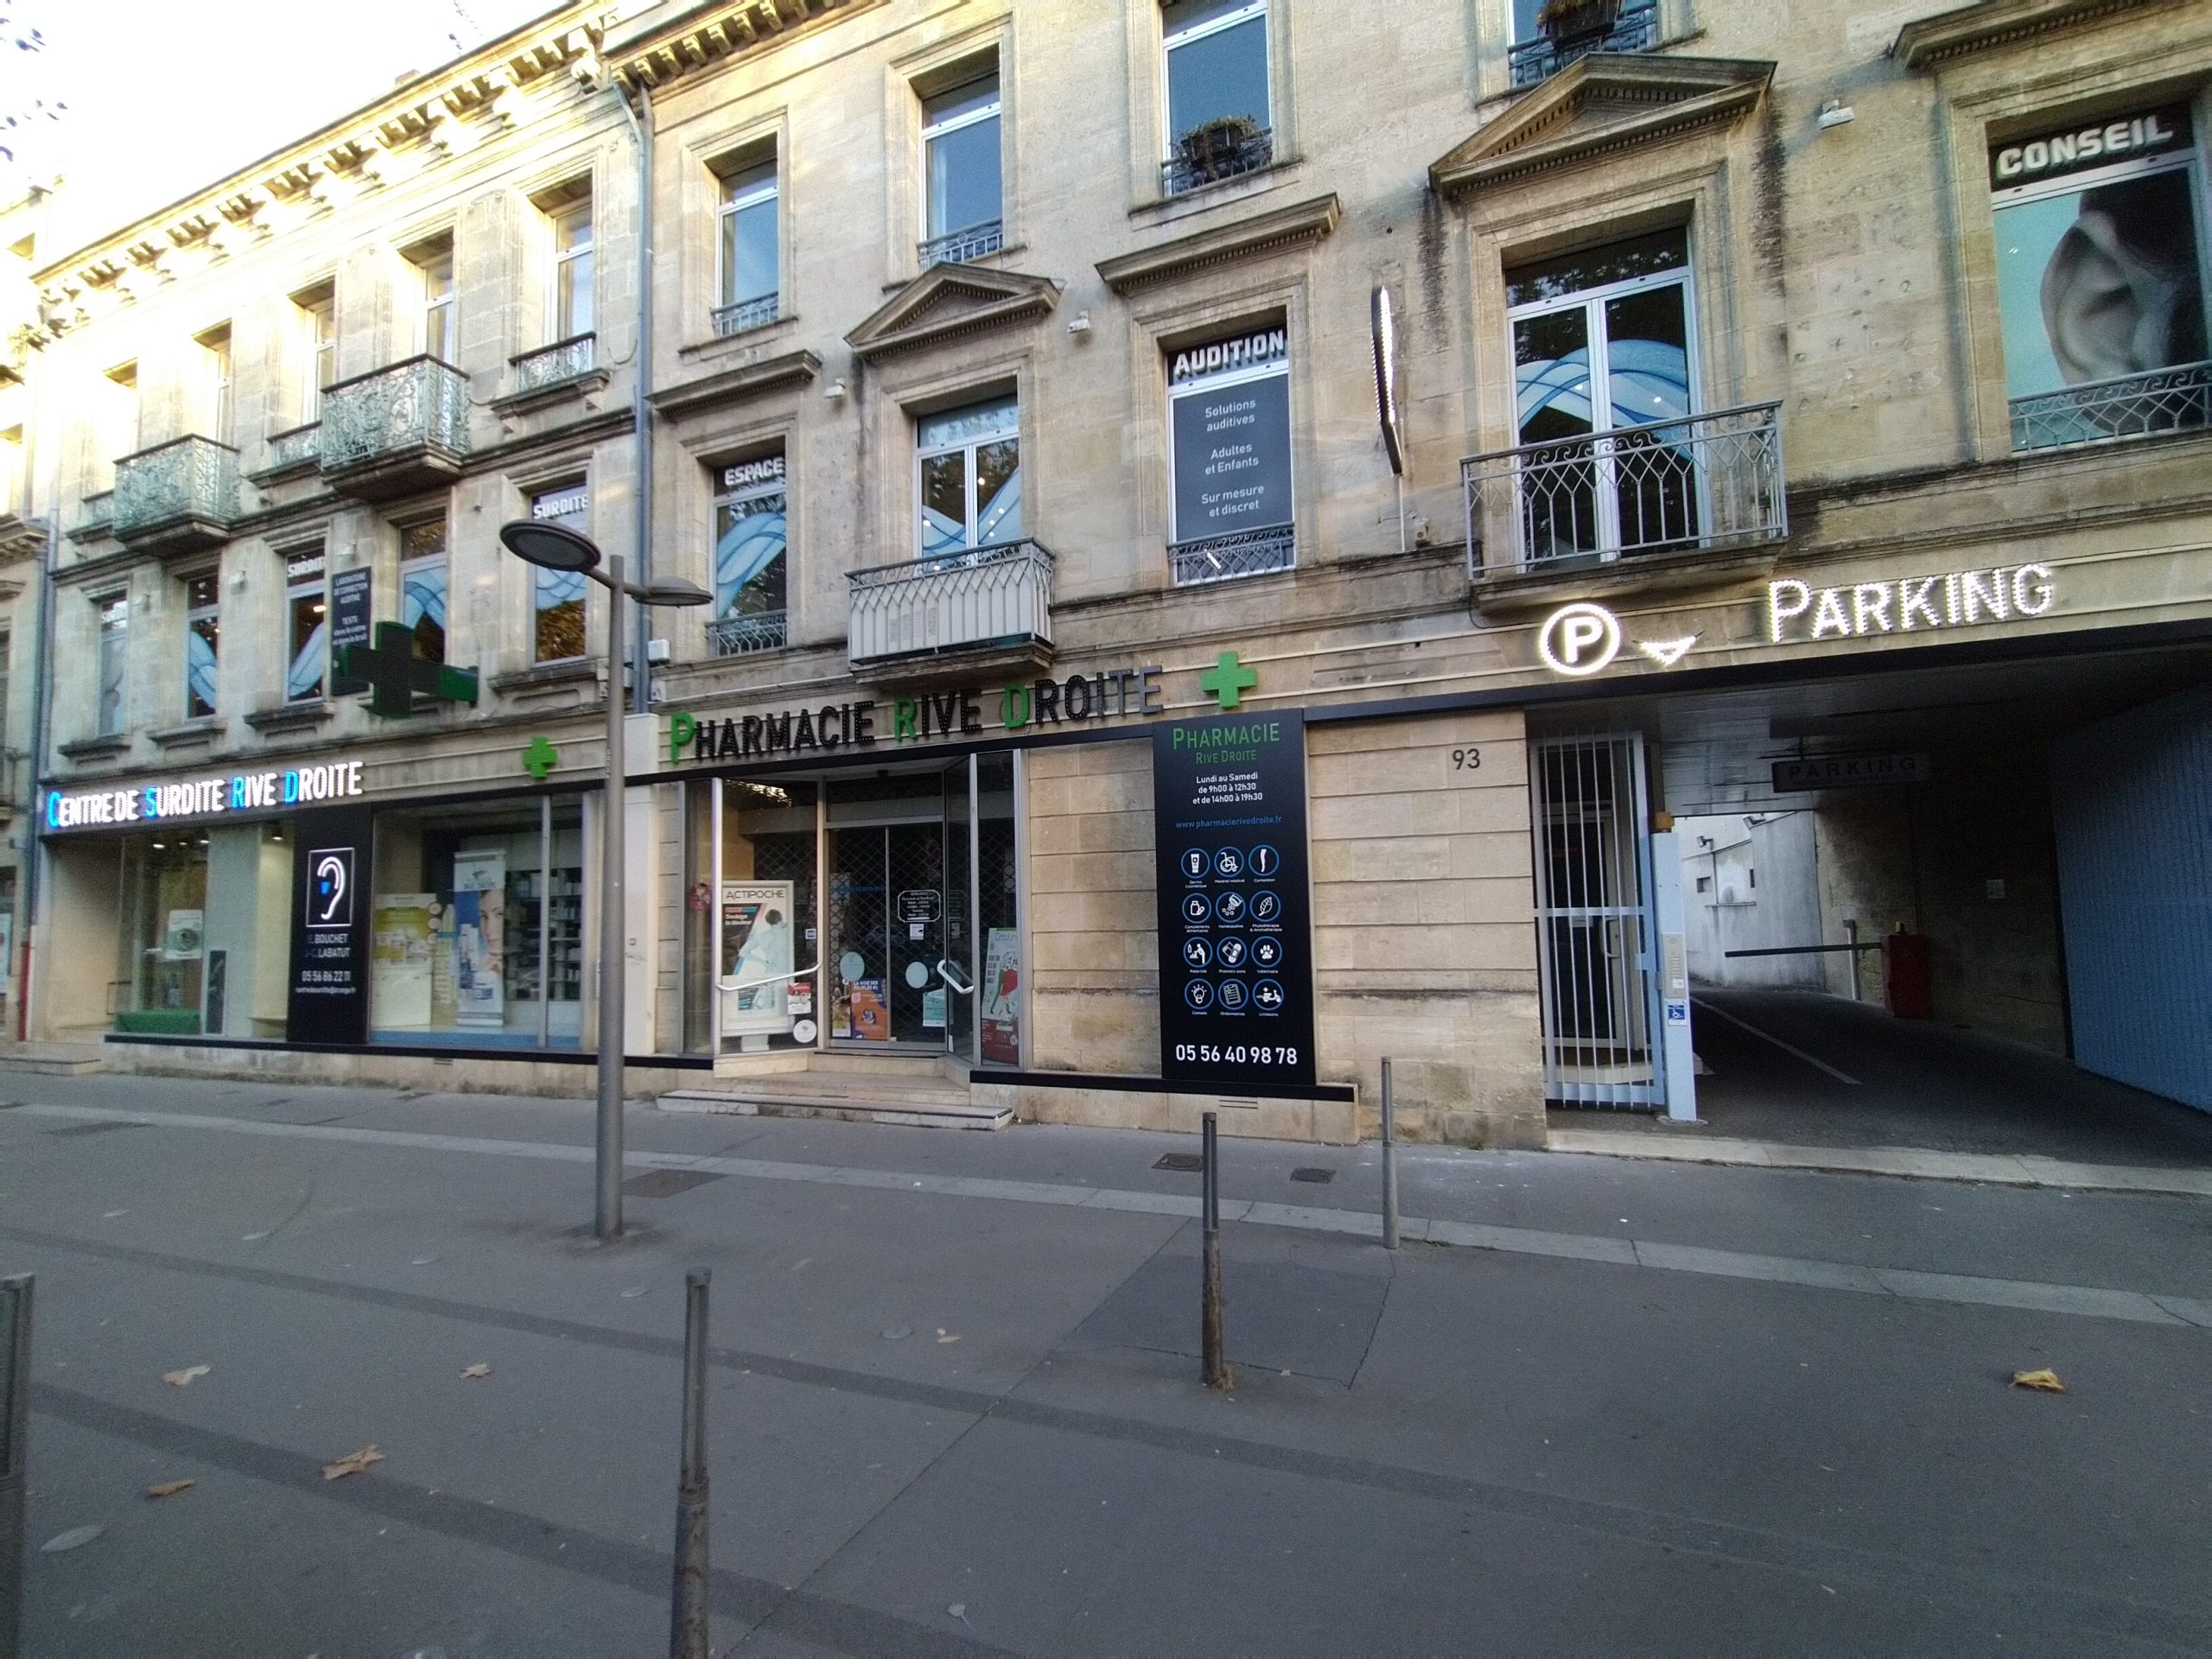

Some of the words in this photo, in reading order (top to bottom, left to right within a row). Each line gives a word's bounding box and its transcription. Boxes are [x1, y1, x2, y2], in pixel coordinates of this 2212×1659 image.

[1997, 114, 2174, 177] CONSEIL
[1174, 329, 1284, 377] AUDITION
[1205, 400, 1256, 418] Solutions
[1206, 415, 1255, 432] auditives
[1211, 443, 1252, 460] Adultes
[724, 456, 784, 486] ESPACE
[1205, 465, 1216, 475] et
[1217, 456, 1260, 474] Enfants
[1201, 493, 1221, 505] Sur
[1223, 485, 1265, 500] mesure
[533, 493, 588, 519] SURDITE
[1210, 505, 1219, 518] et
[1222, 499, 1260, 515] discret
[288, 556, 326, 577] SURDIT
[1767, 563, 2053, 644] PARKING
[1563, 616, 1604, 663] P
[670, 701, 875, 766] PHARMACIE
[894, 689, 982, 742] RIVE
[1004, 664, 1164, 729] DROITE
[1173, 722, 1281, 750] PHARMACIE
[1196, 752, 1219, 765] RIVE
[1221, 749, 1257, 763] DROITE
[1452, 747, 1481, 771] 93
[1789, 756, 1916, 779] PARKING
[1196, 774, 1217, 784] Lundi
[1229, 772, 1258, 782] Samedi
[1198, 785, 1207, 794] de
[1208, 784, 1228, 793] 9h00
[1234, 782, 1256, 791] 12h30
[48, 791, 114, 829] CENTRE
[115, 790, 140, 822] DE
[145, 779, 226, 819] SURDITE
[232, 773, 278, 810] RIVE
[284, 760, 364, 804] DROITE
[1211, 794, 1234, 803] 14h00
[1235, 793, 1240, 802] à
[1241, 792, 1263, 802] 19h30
[1175, 815, 1283, 829] www.pharmacierivedroite.fr
[725, 890, 785, 900] ACTIPOCHE
[301, 970, 312, 982] 05
[333, 970, 343, 982] 22
[1175, 1044, 1196, 1061] 05
[1200, 1045, 1221, 1062] 56
[1224, 1046, 1246, 1063] 40
[1250, 1046, 1272, 1064] 98
[1275, 1047, 1298, 1065] 78
